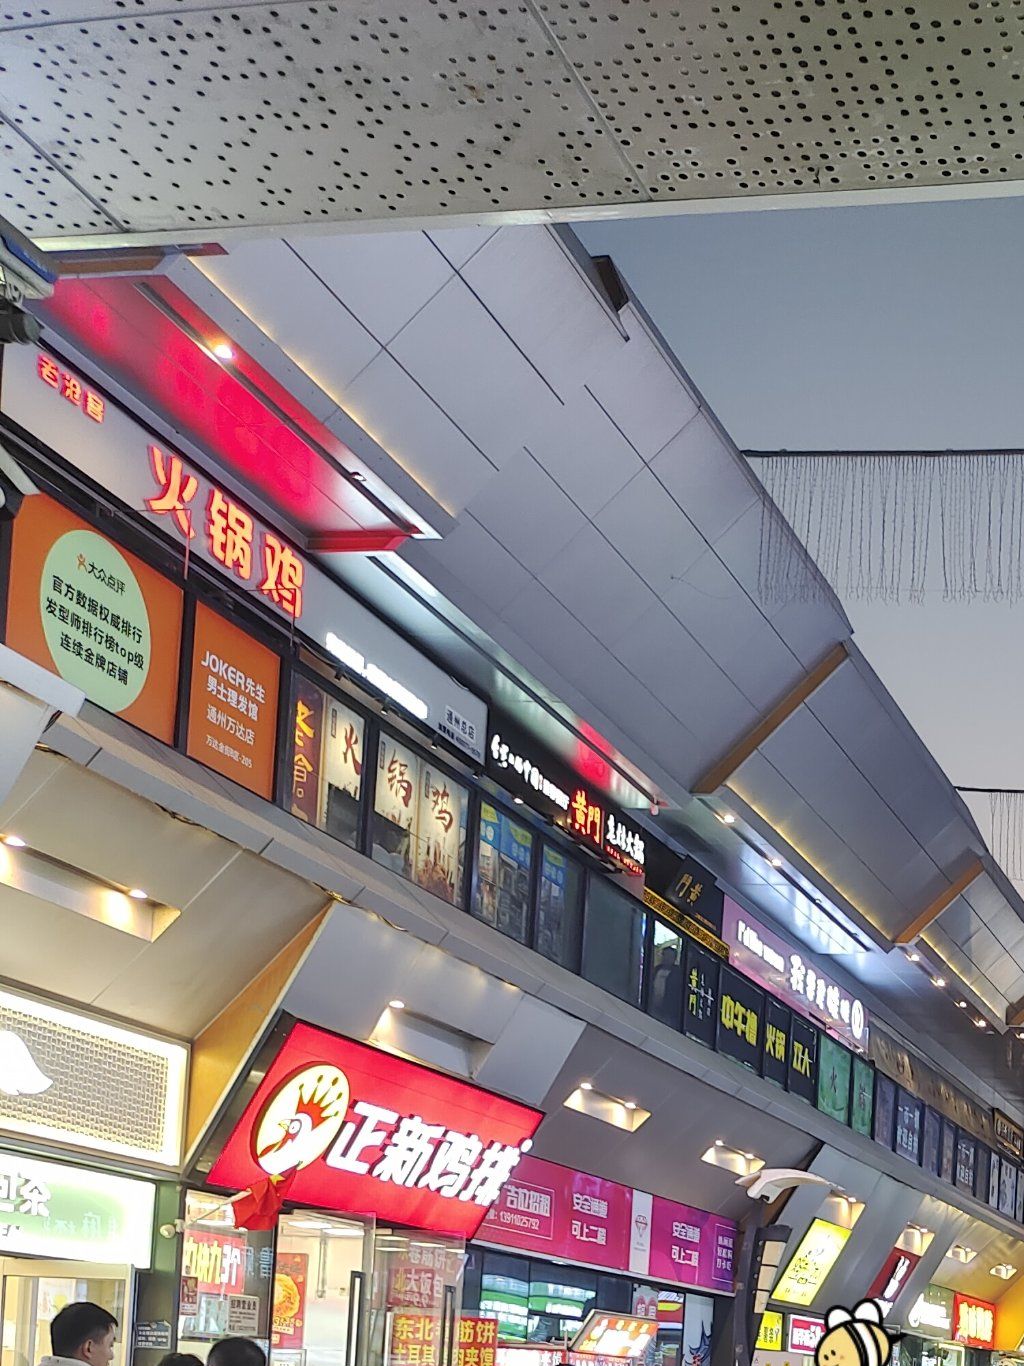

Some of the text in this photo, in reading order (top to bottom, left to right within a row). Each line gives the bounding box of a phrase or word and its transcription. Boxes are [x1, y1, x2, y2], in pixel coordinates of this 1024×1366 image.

[146, 443, 305, 619] 火锅鸡
[88, 562, 126, 596] 大众点评
[46, 596, 144, 671] 发型师排行榜top级
[52, 574, 143, 644] 官方数据权威排行
[60, 631, 129, 686] 连续金牌店铺
[201, 650, 266, 704] JOKER先生
[206, 674, 258, 721] 男士理发馆
[207, 704, 255, 746] 通州万达店
[343, 722, 362, 777] 火
[388, 749, 413, 808] 锅
[432, 782, 454, 833] 鸡
[324, 1099, 532, 1207] 正新鸡排
[496, 1184, 551, 1217] 告位招租
[572, 1192, 608, 1219] 安全通道
[672, 1221, 701, 1243] 安全通道
